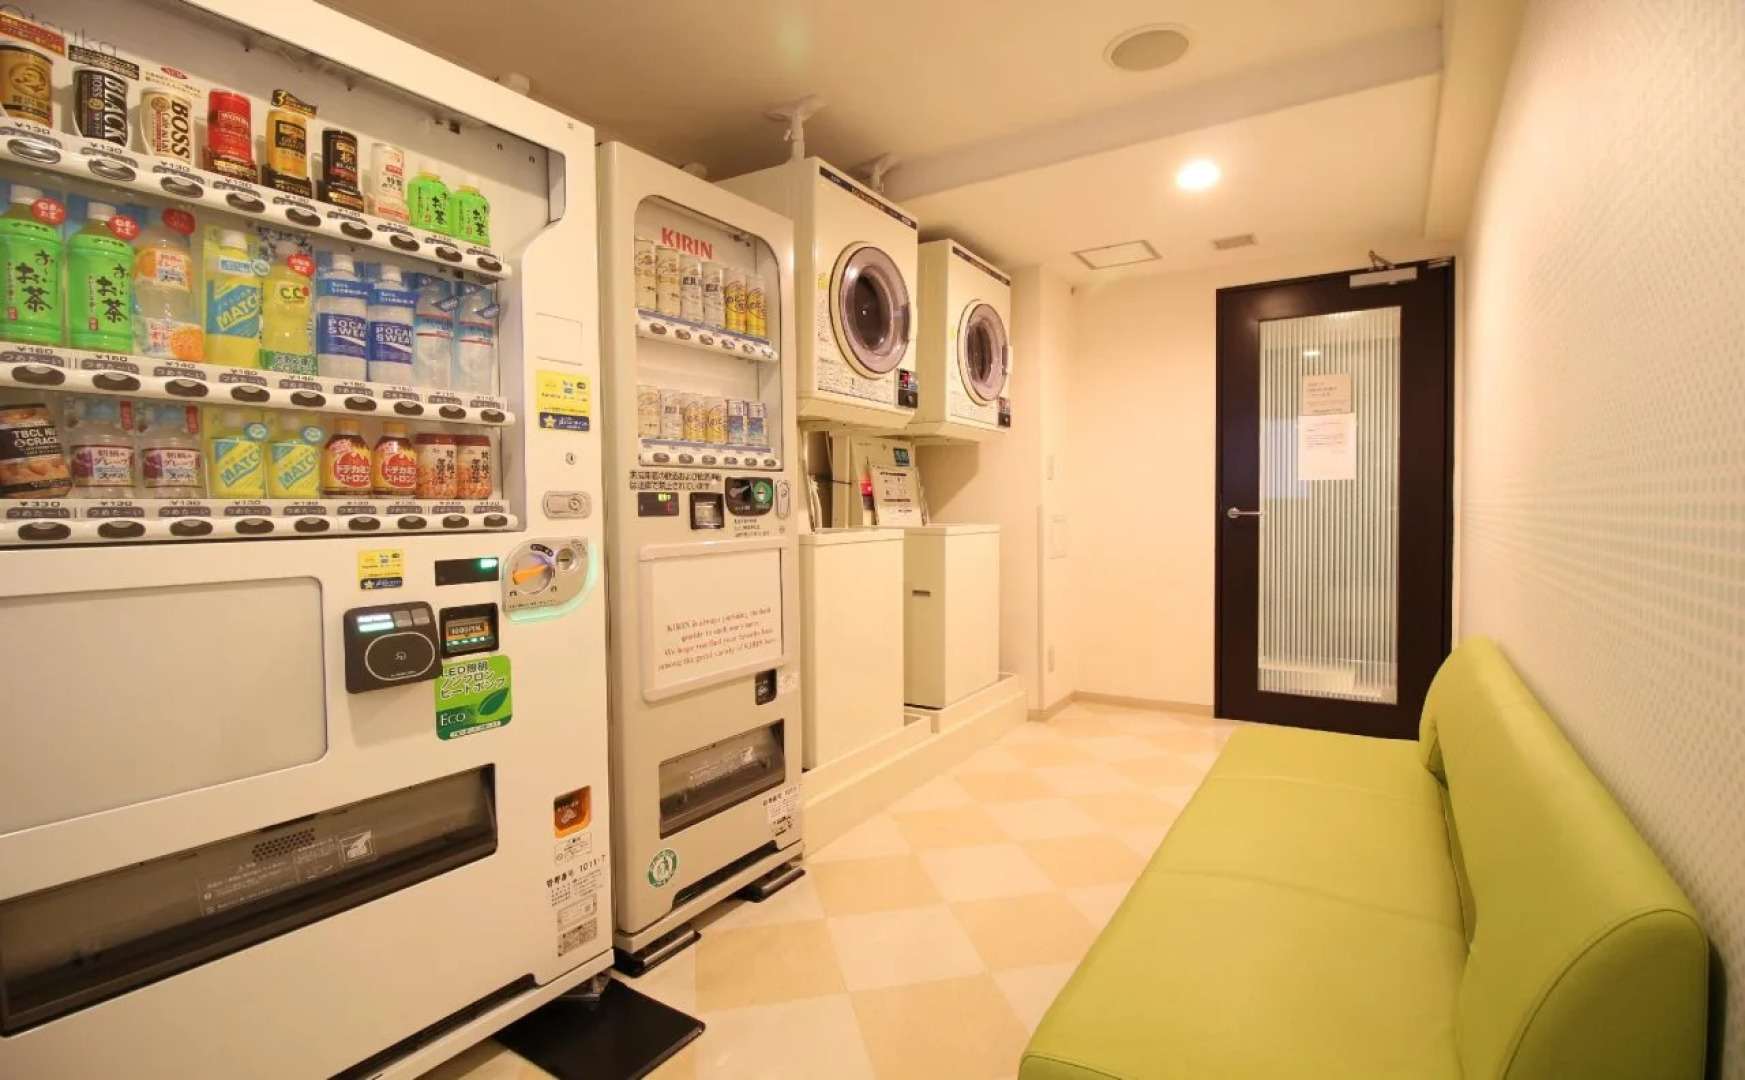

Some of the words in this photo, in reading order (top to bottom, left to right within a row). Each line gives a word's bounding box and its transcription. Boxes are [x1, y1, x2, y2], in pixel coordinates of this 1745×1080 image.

[103, 76, 126, 145] BLACK
[170, 99, 190, 159] BOSS
[661, 226, 714, 260] KIRIN
[218, 293, 259, 332] MATC
[328, 318, 366, 331] POCA
[328, 326, 365, 339] SWEA
[376, 333, 411, 345] SWEA
[220, 445, 262, 488] MATC
[278, 447, 319, 490] MATC
[384, 465, 416, 475] ドデカミ
[443, 660, 489, 677] LED照明
[441, 671, 496, 689] ノンフロン
[441, 677, 506, 699] ヒートポンプ
